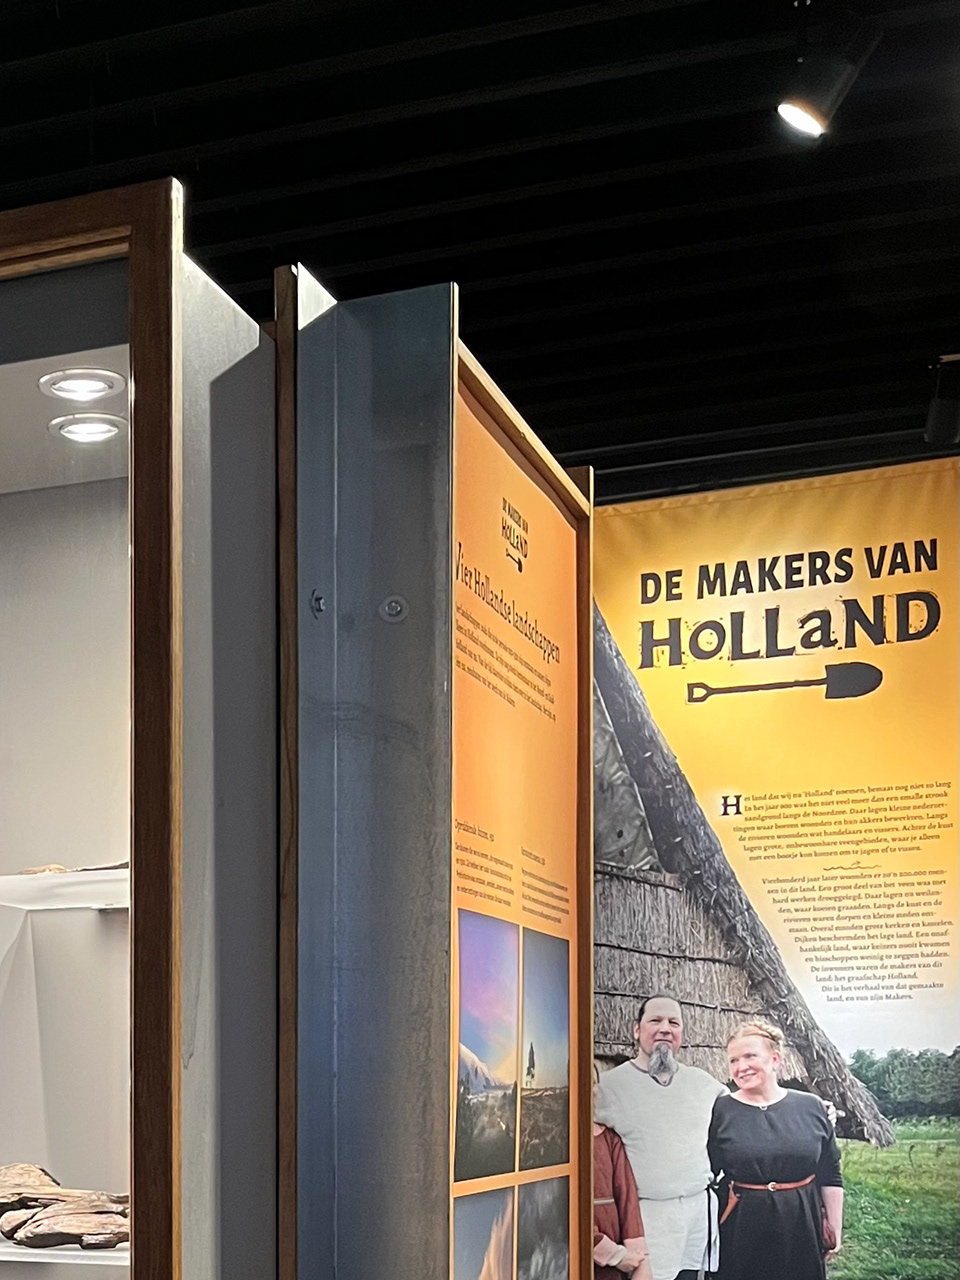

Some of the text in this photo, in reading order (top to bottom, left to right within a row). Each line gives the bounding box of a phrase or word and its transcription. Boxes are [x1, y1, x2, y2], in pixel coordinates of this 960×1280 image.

[640, 538, 938, 605] DE MAKERS VAN
[473, 567, 511, 624] Hollandse
[512, 600, 560, 664] landschappen
